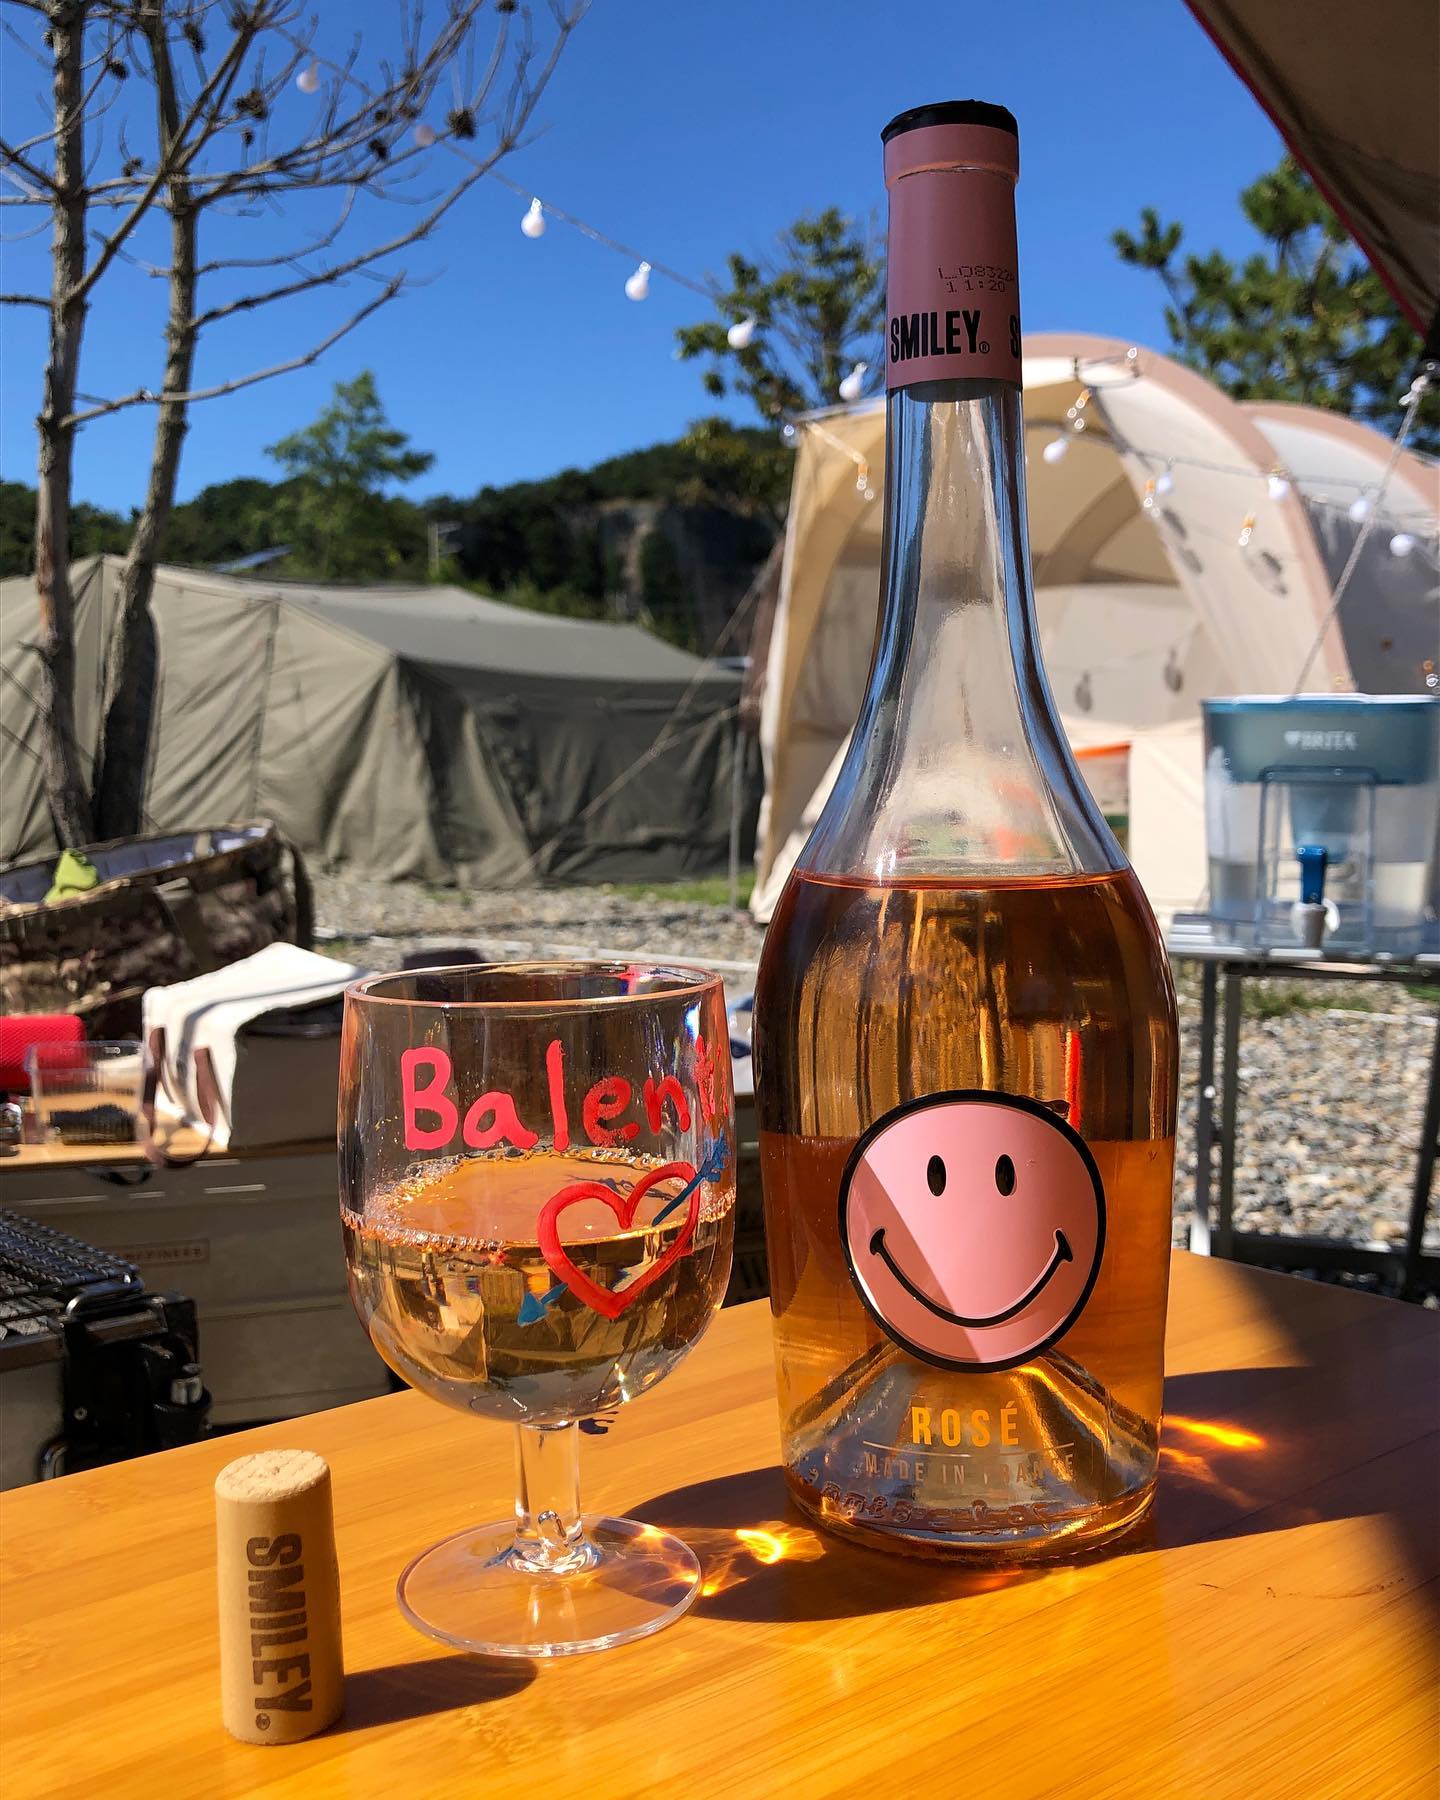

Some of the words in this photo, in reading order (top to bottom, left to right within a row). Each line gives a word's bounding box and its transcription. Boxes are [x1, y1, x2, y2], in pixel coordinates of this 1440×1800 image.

[911, 1401, 1019, 1446] ROSÉ
[863, 1451, 925, 1482] MADE
[942, 1463, 965, 1485] IN
